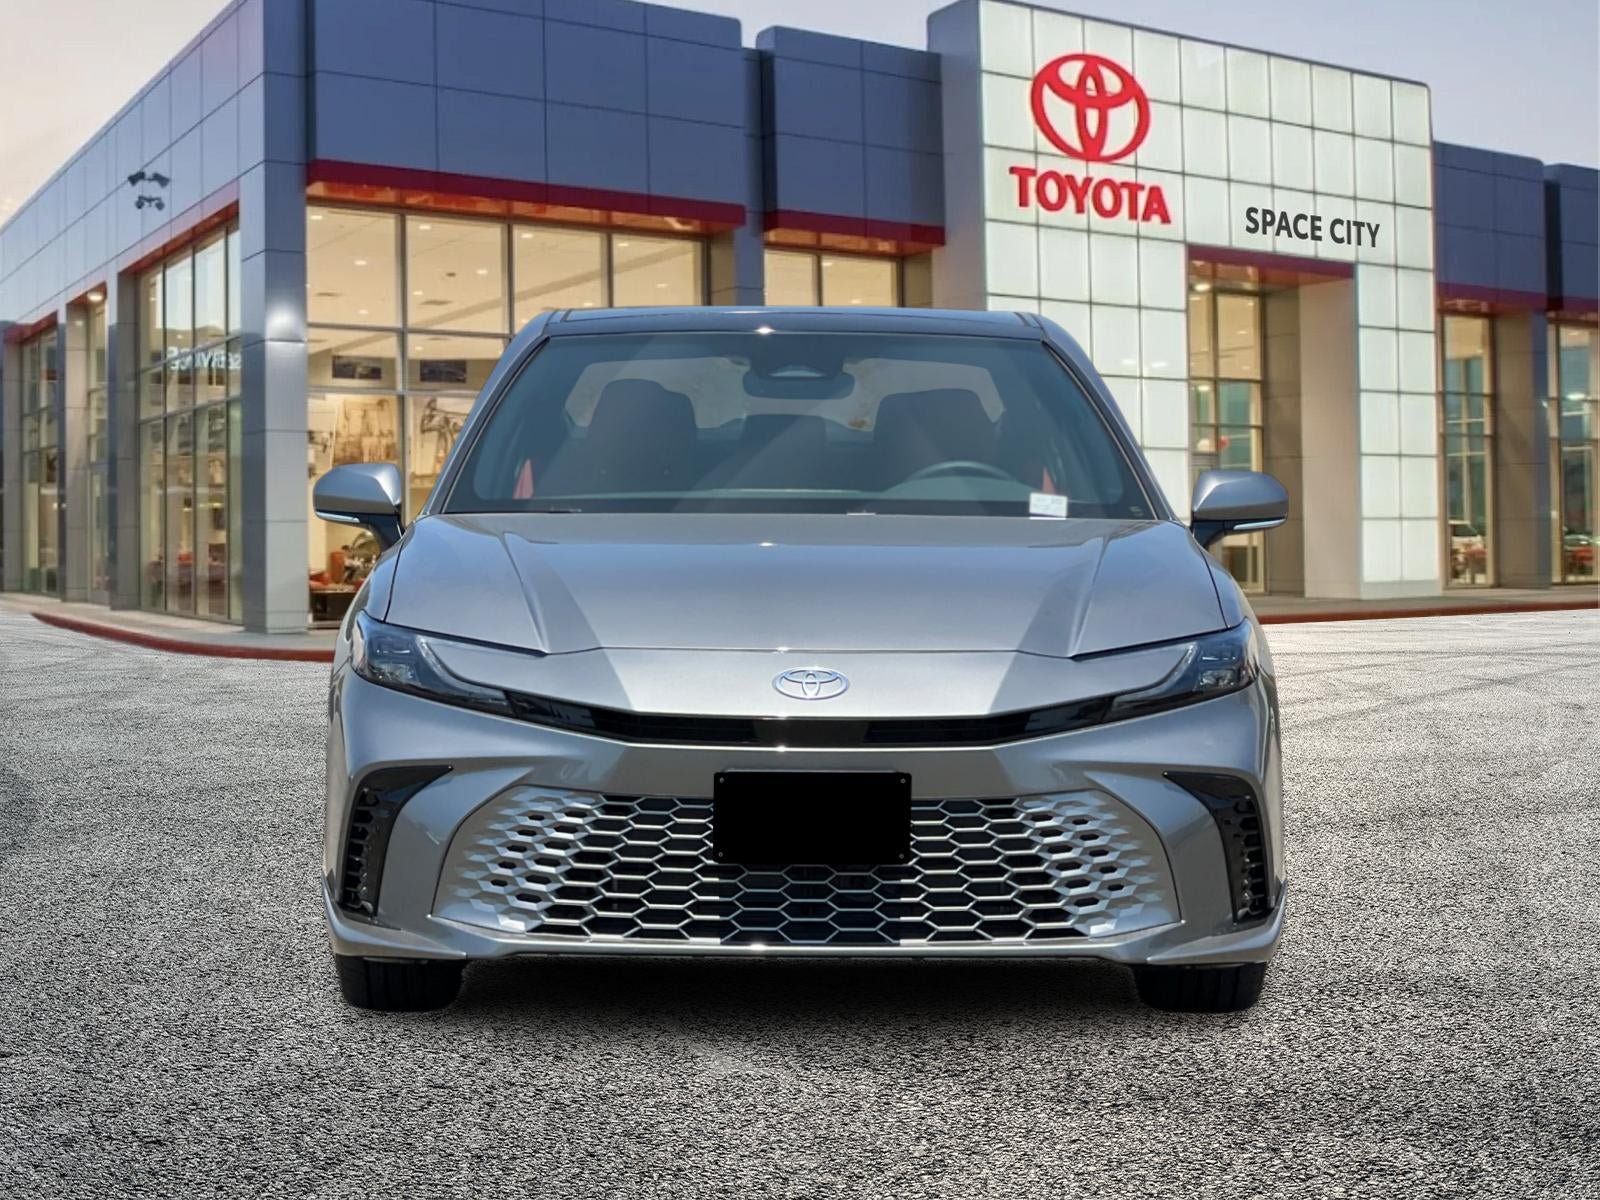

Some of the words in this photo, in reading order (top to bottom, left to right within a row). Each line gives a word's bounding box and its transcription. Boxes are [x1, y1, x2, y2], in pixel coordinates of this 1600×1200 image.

[1009, 167, 1171, 224] TOYOTA
[1246, 207, 1322, 242] SPACE
[1330, 219, 1380, 247] CITY
